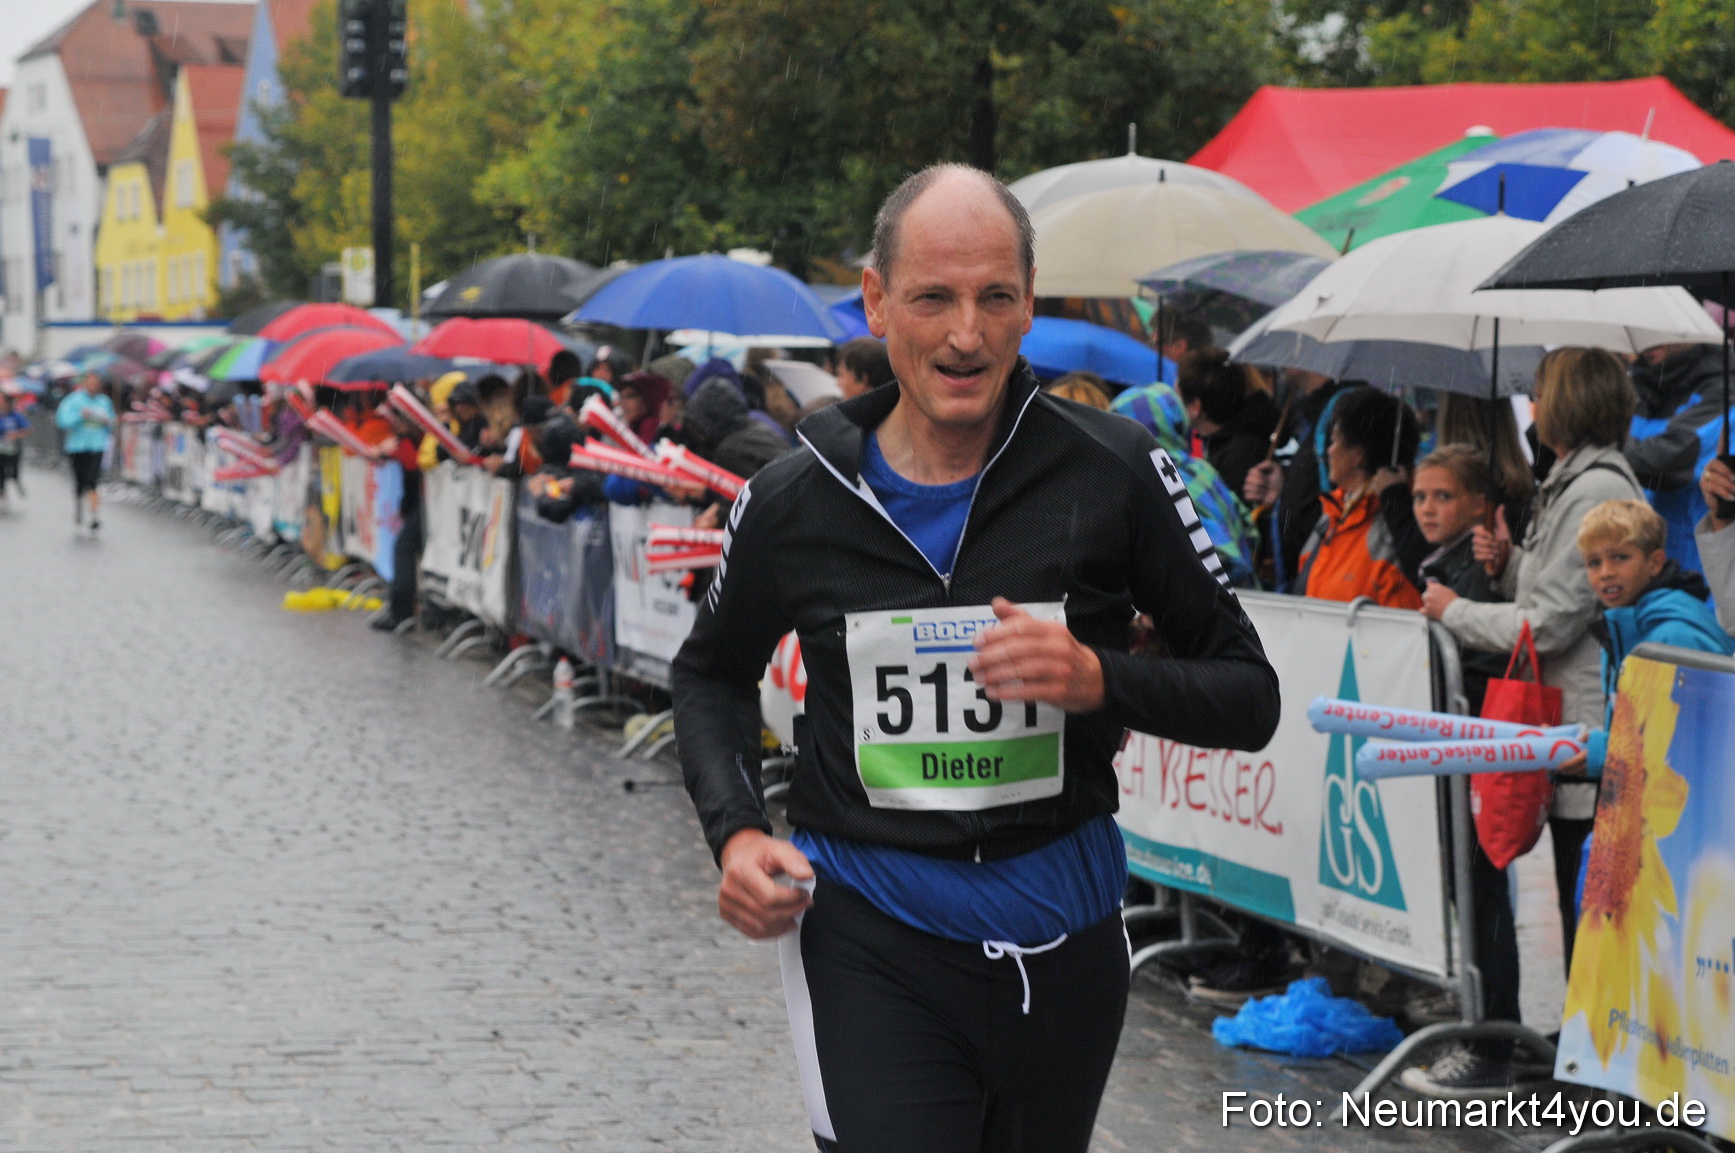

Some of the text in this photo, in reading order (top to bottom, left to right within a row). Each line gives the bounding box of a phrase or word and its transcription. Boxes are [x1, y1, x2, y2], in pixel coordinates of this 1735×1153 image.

[1323, 702, 1454, 739] ReiseCenter
[921, 752, 1004, 781] Dieter
[1376, 739, 1536, 766] TUI ReiseCenter
